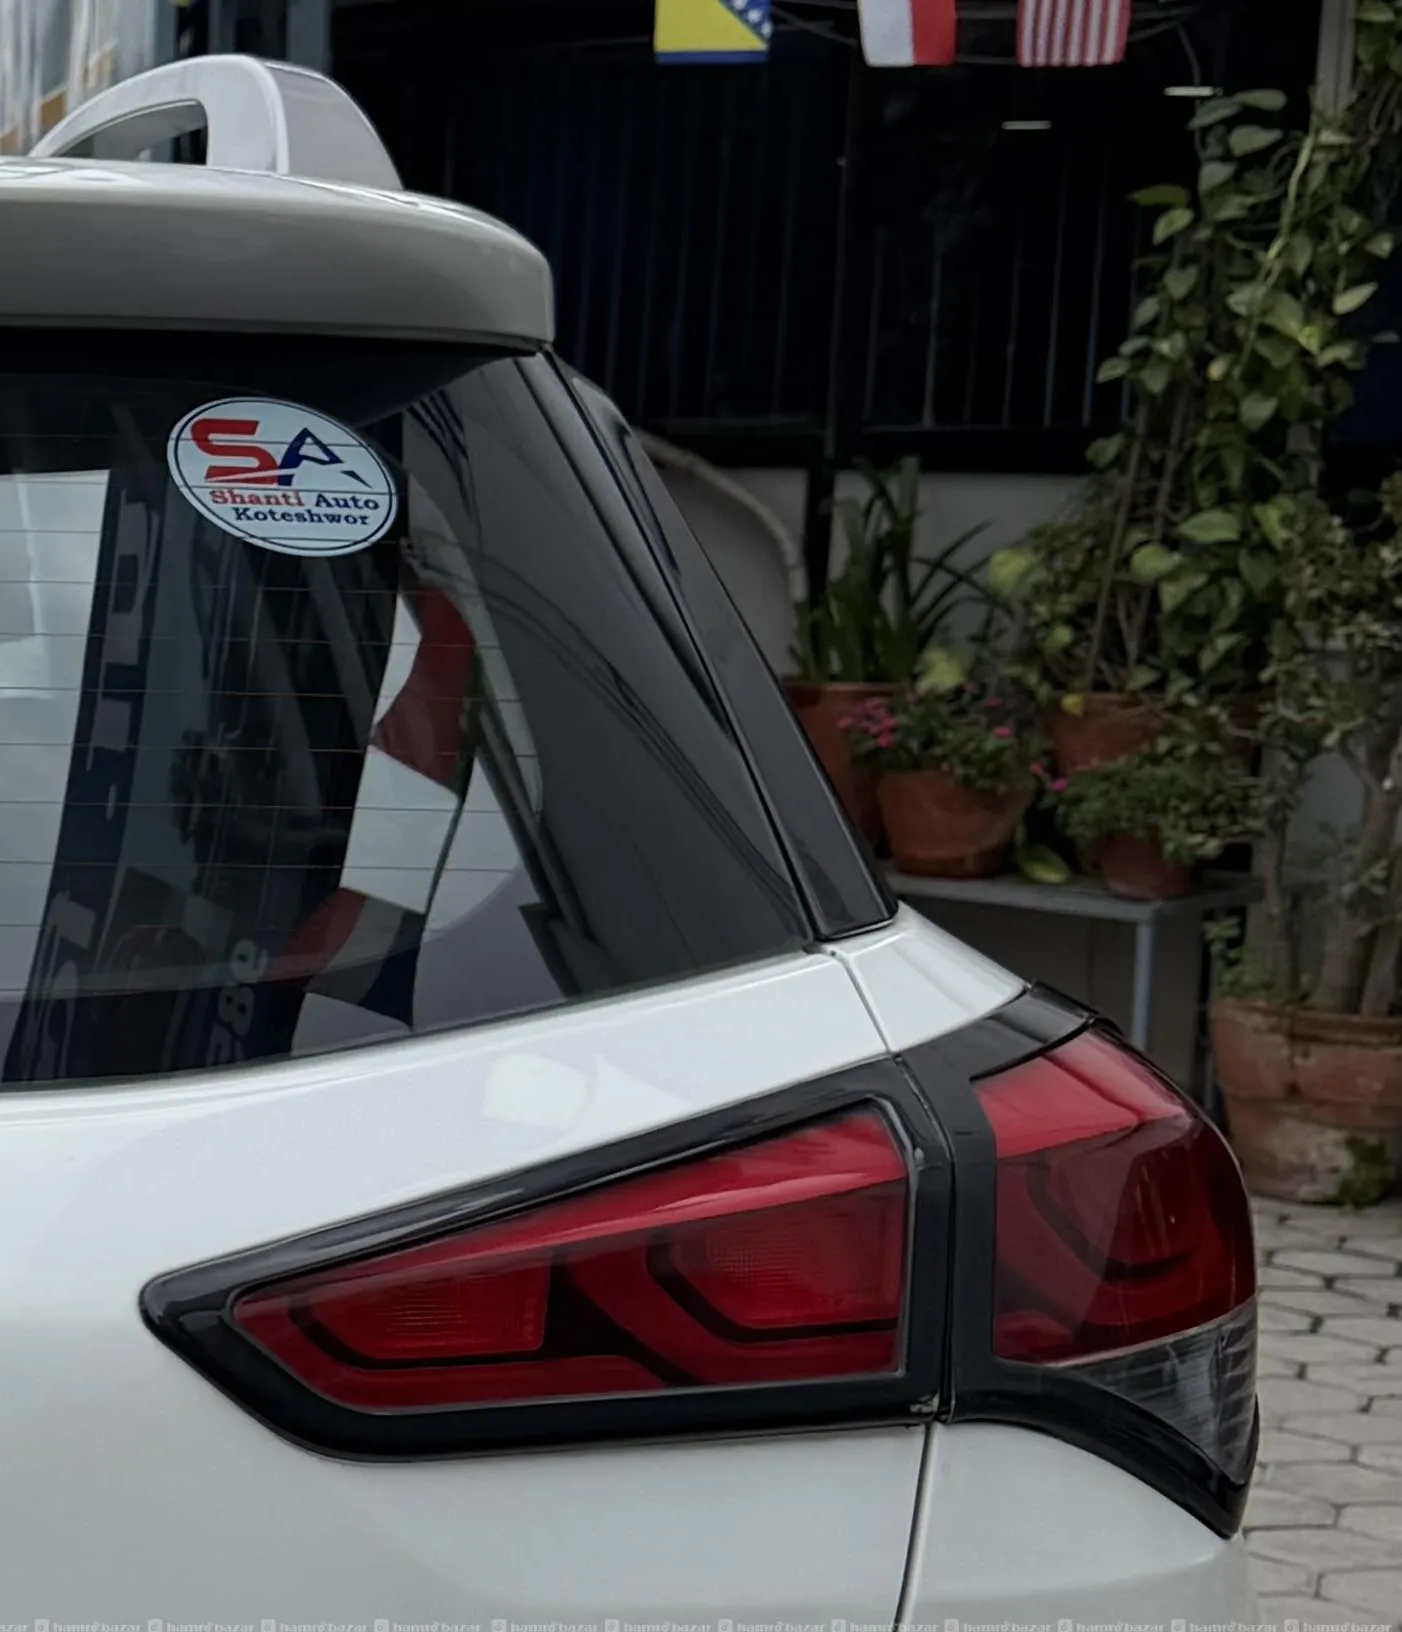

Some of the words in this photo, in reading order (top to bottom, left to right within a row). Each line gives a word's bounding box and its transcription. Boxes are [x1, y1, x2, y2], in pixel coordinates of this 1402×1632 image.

[190, 418, 373, 489] SA
[209, 489, 305, 507] Shanti
[314, 493, 381, 511] Auto
[234, 507, 370, 525] Koteshwor
